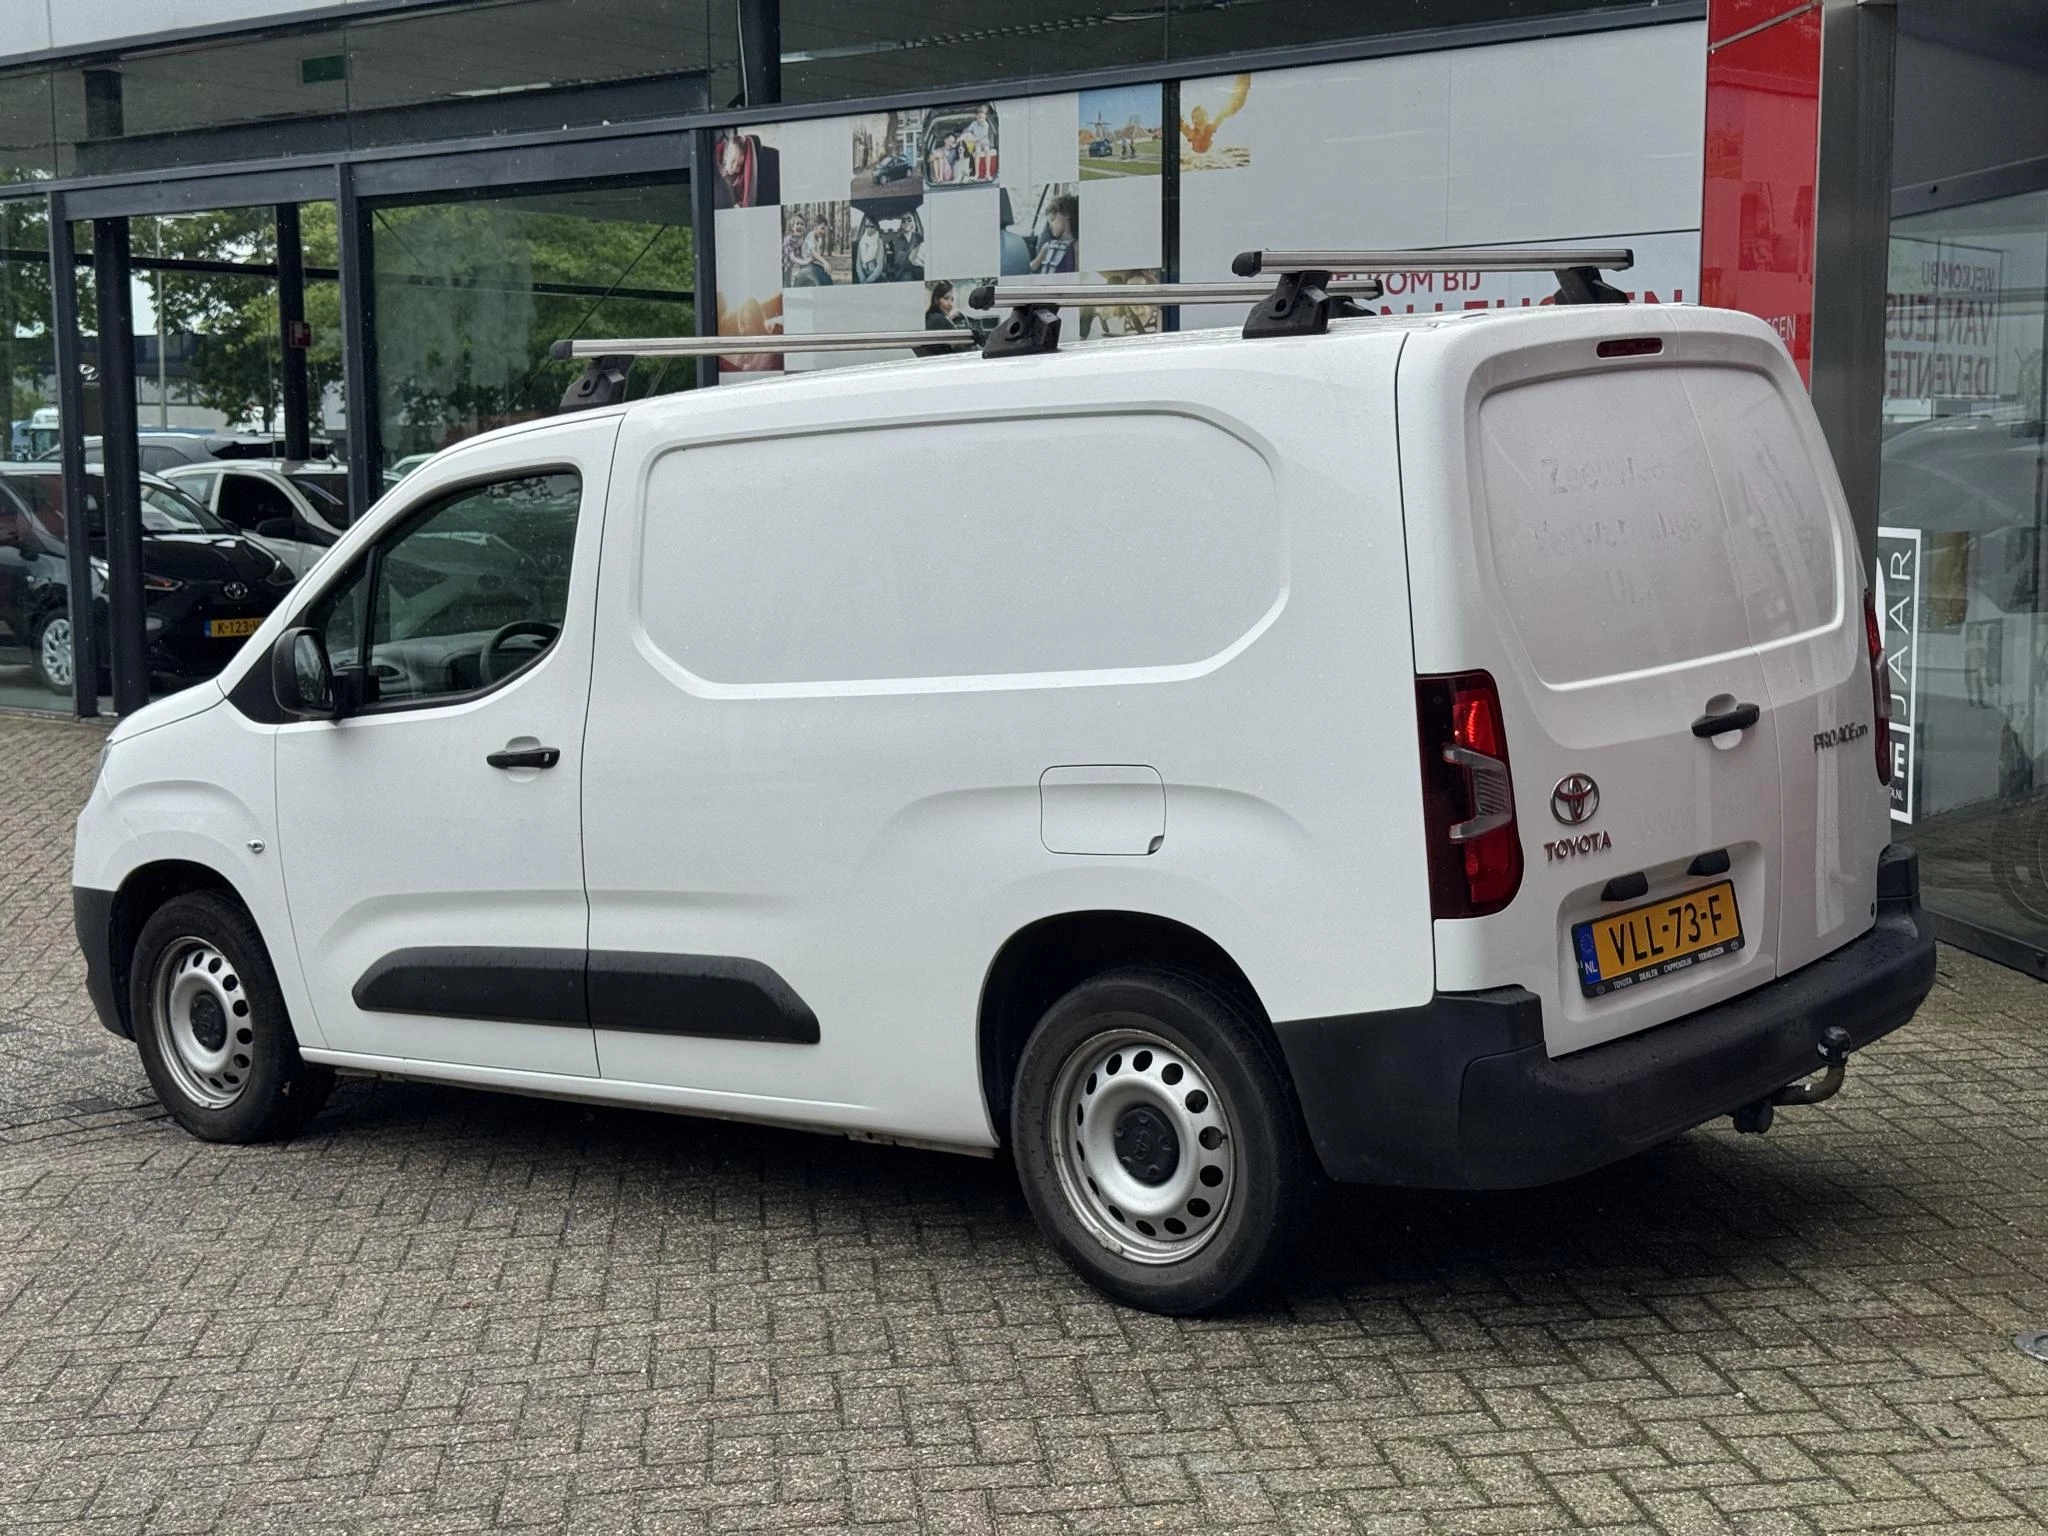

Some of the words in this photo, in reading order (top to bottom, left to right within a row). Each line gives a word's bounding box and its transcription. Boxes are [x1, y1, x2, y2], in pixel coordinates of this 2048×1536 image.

[1444, 272, 1481, 291] BIJ
[1888, 549, 1911, 716] JAAR
[1543, 830, 1612, 862] TOYOTA
[1584, 960, 1598, 976] NL
[1609, 894, 1722, 966] VLL-73-F
[1613, 977, 1633, 990] TOYOTA
[1639, 968, 1659, 981] DEALER
